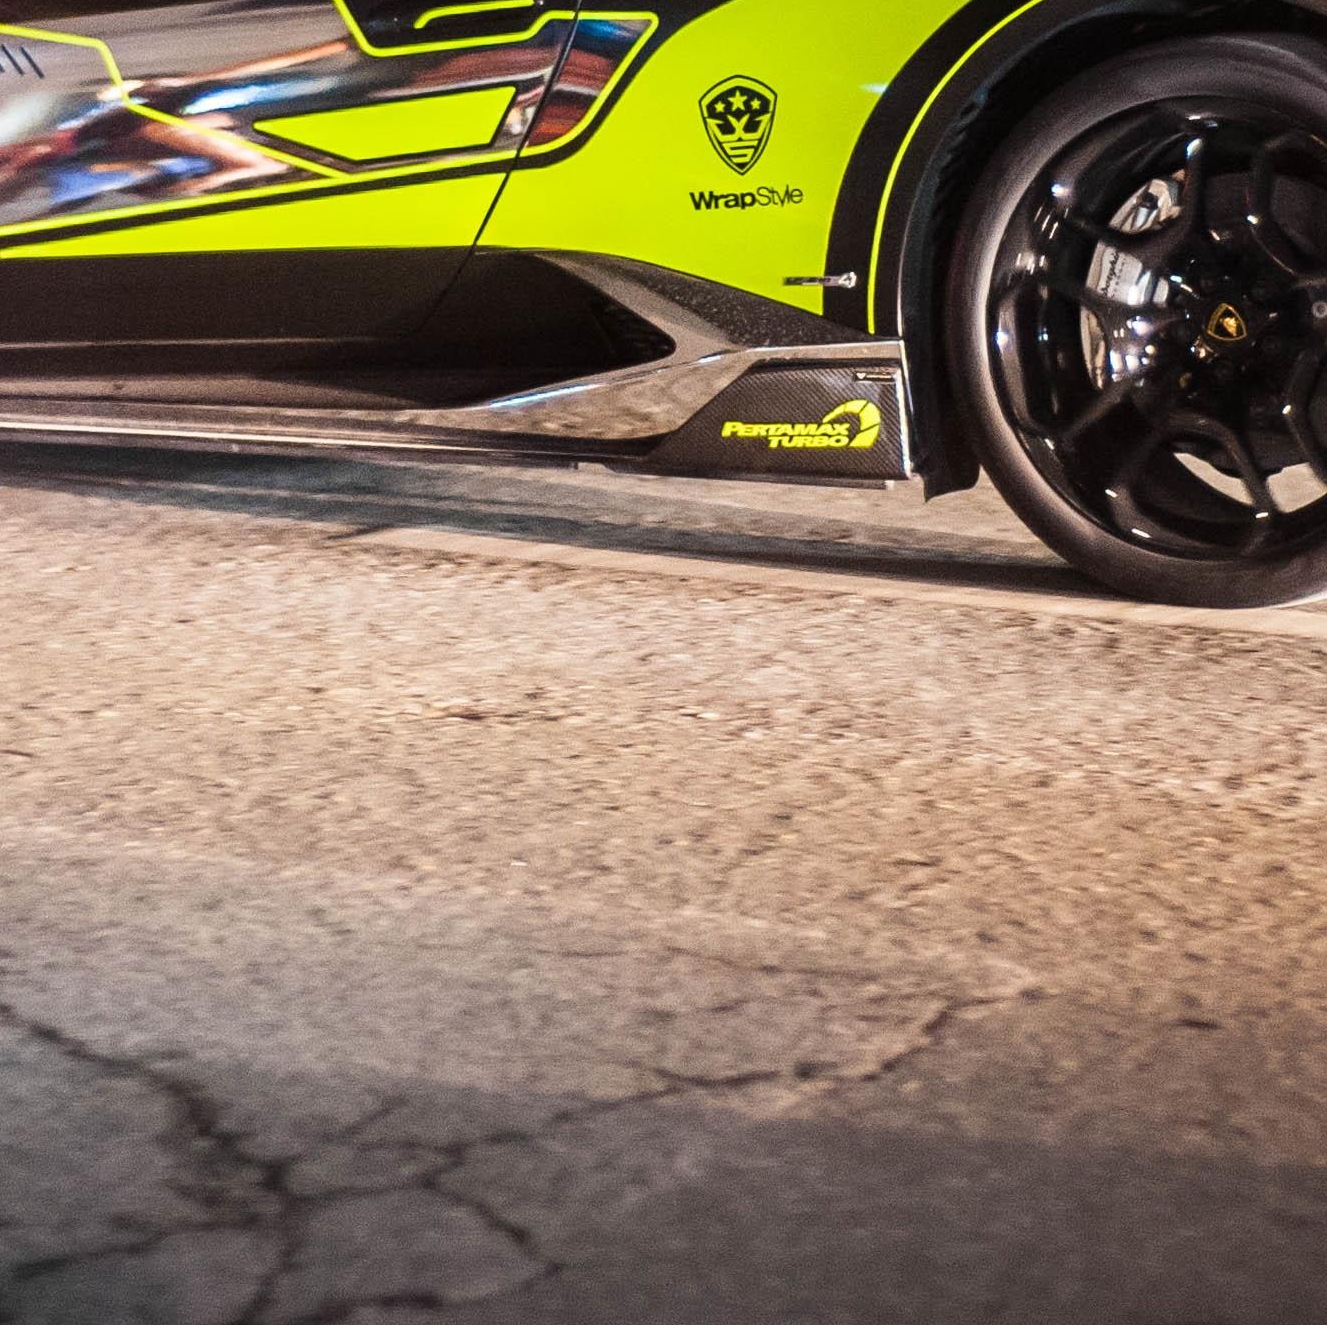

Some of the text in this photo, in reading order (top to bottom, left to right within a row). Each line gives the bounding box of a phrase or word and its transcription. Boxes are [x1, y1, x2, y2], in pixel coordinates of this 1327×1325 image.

[689, 184, 804, 211] WrapStyle
[722, 421, 851, 438] PERTAMAX
[768, 435, 850, 449] TURBO
